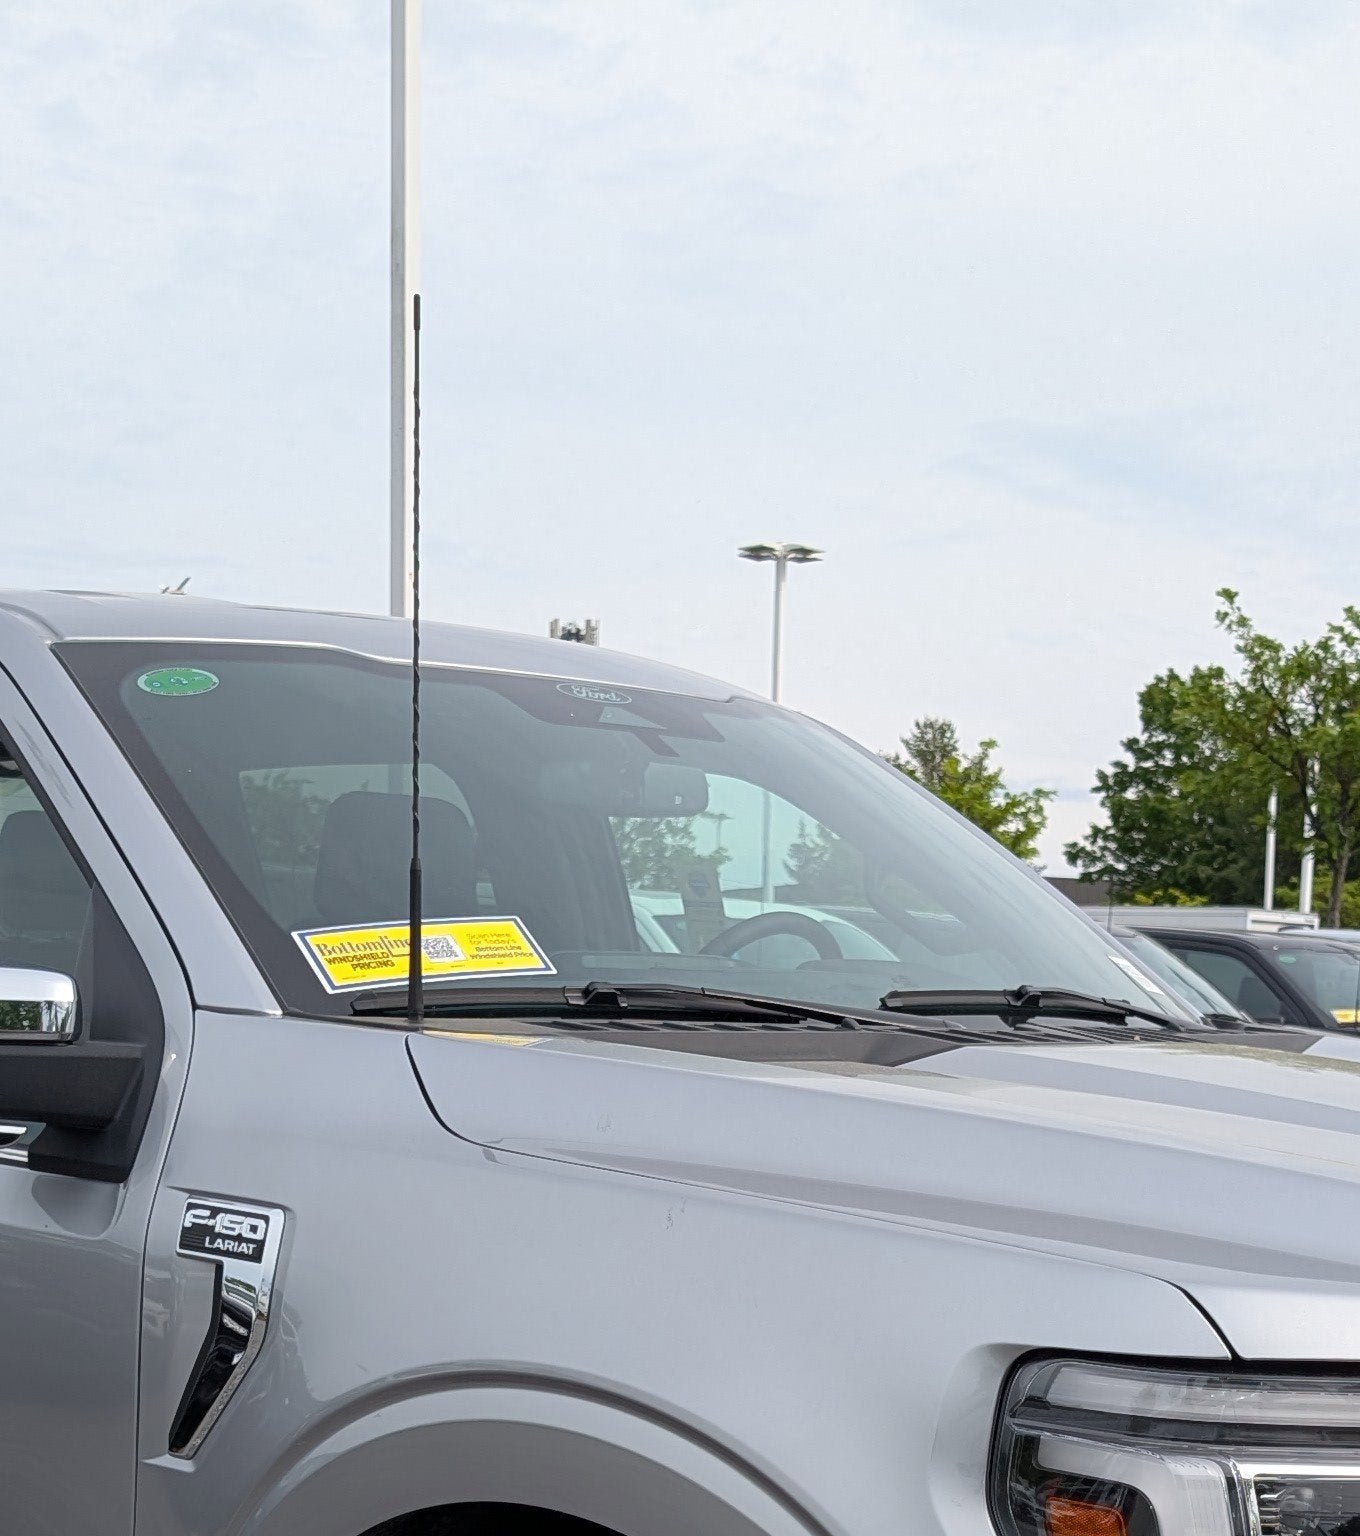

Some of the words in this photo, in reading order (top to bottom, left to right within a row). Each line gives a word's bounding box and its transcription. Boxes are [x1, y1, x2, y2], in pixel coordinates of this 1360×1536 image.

[325, 951, 390, 966] WINDSHIELD
[350, 960, 395, 971] PRICING
[184, 1208, 267, 1241] F-150
[204, 1237, 258, 1256] LARIAT
